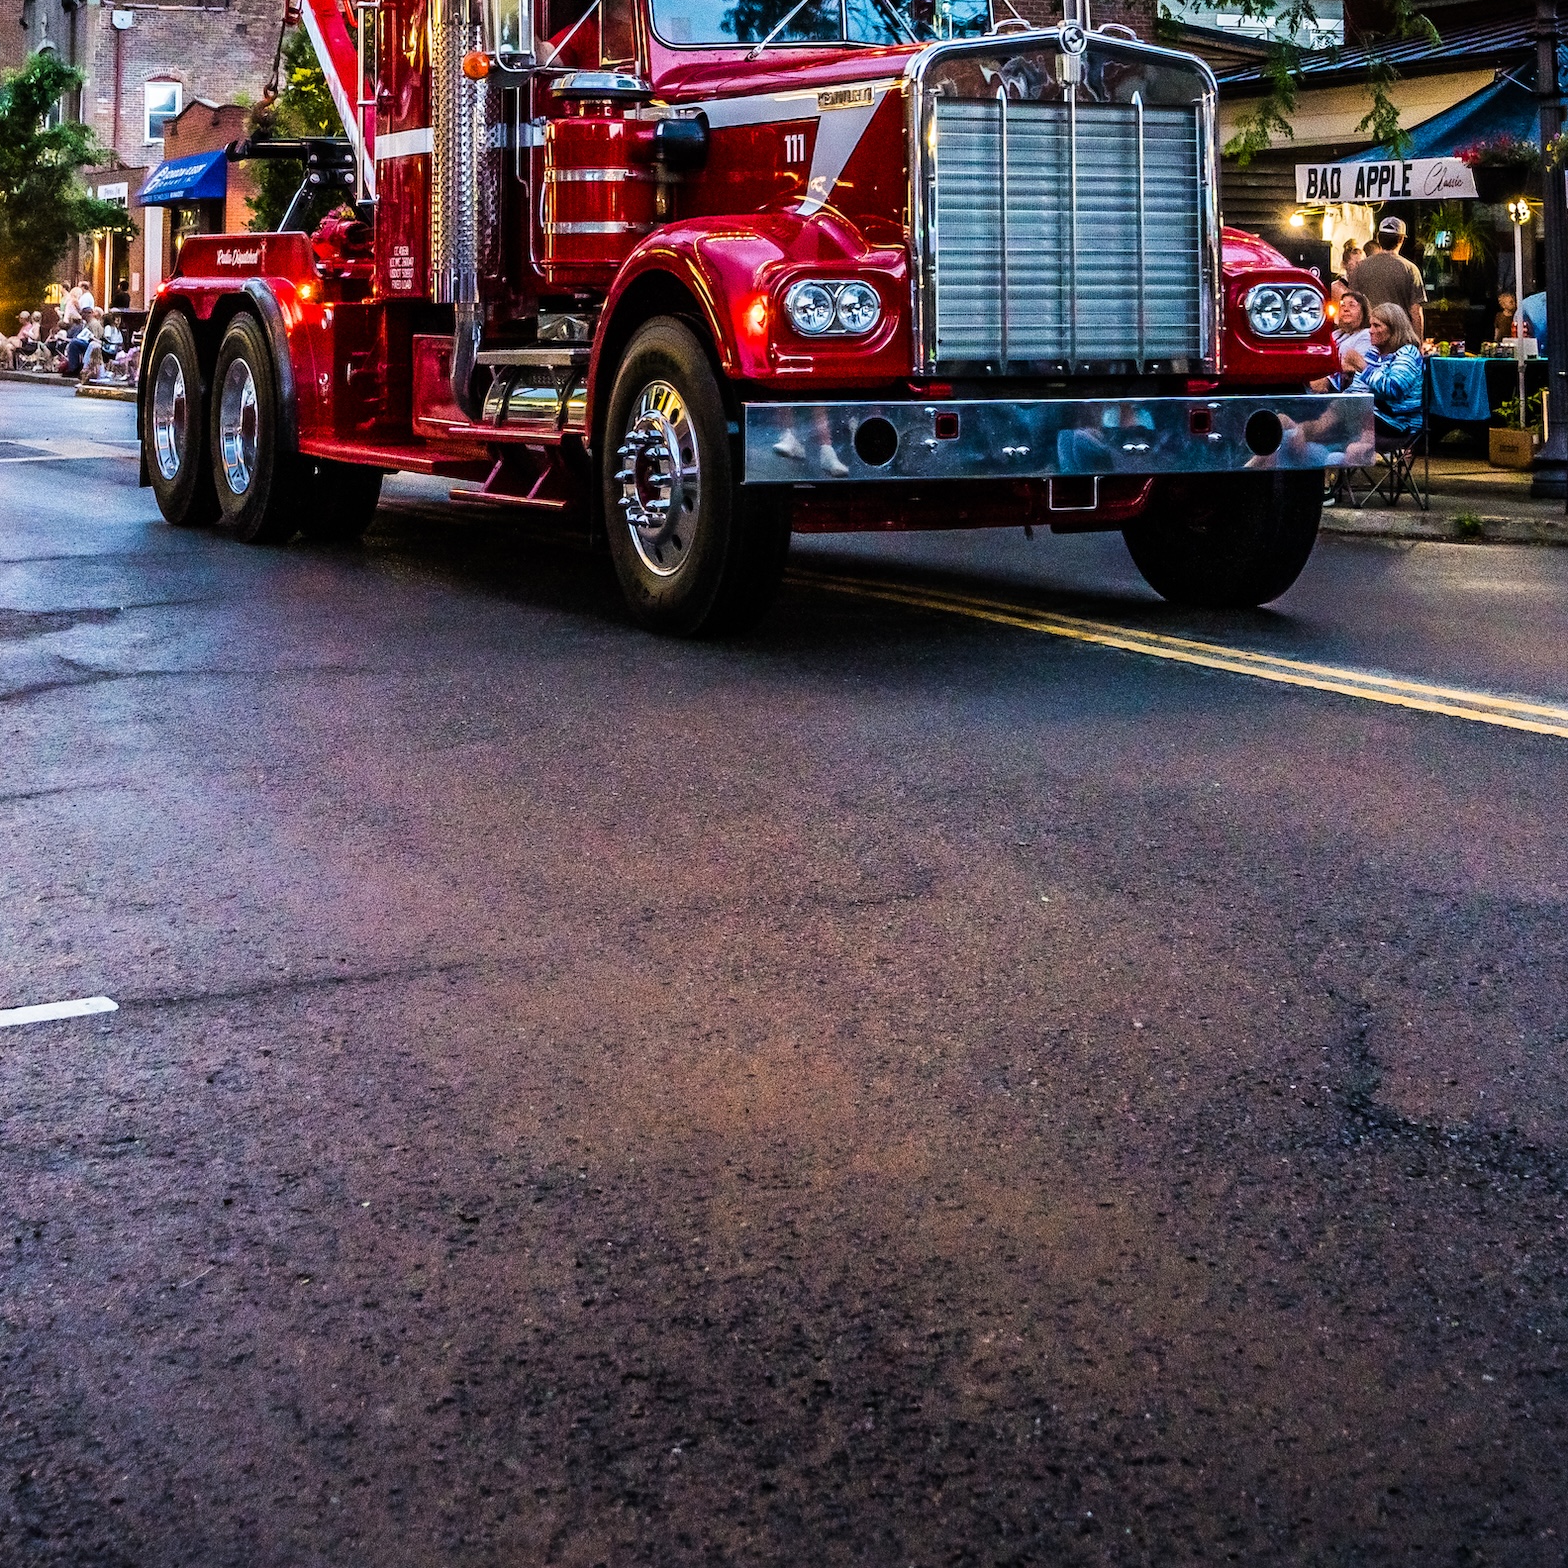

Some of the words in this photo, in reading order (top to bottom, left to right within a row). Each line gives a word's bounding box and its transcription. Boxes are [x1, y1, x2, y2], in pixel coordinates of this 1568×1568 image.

[784, 134, 805, 163] 111
[1306, 167, 1341, 199] BAD
[1354, 164, 1413, 198] APPLE
[1423, 161, 1464, 196] Classic
